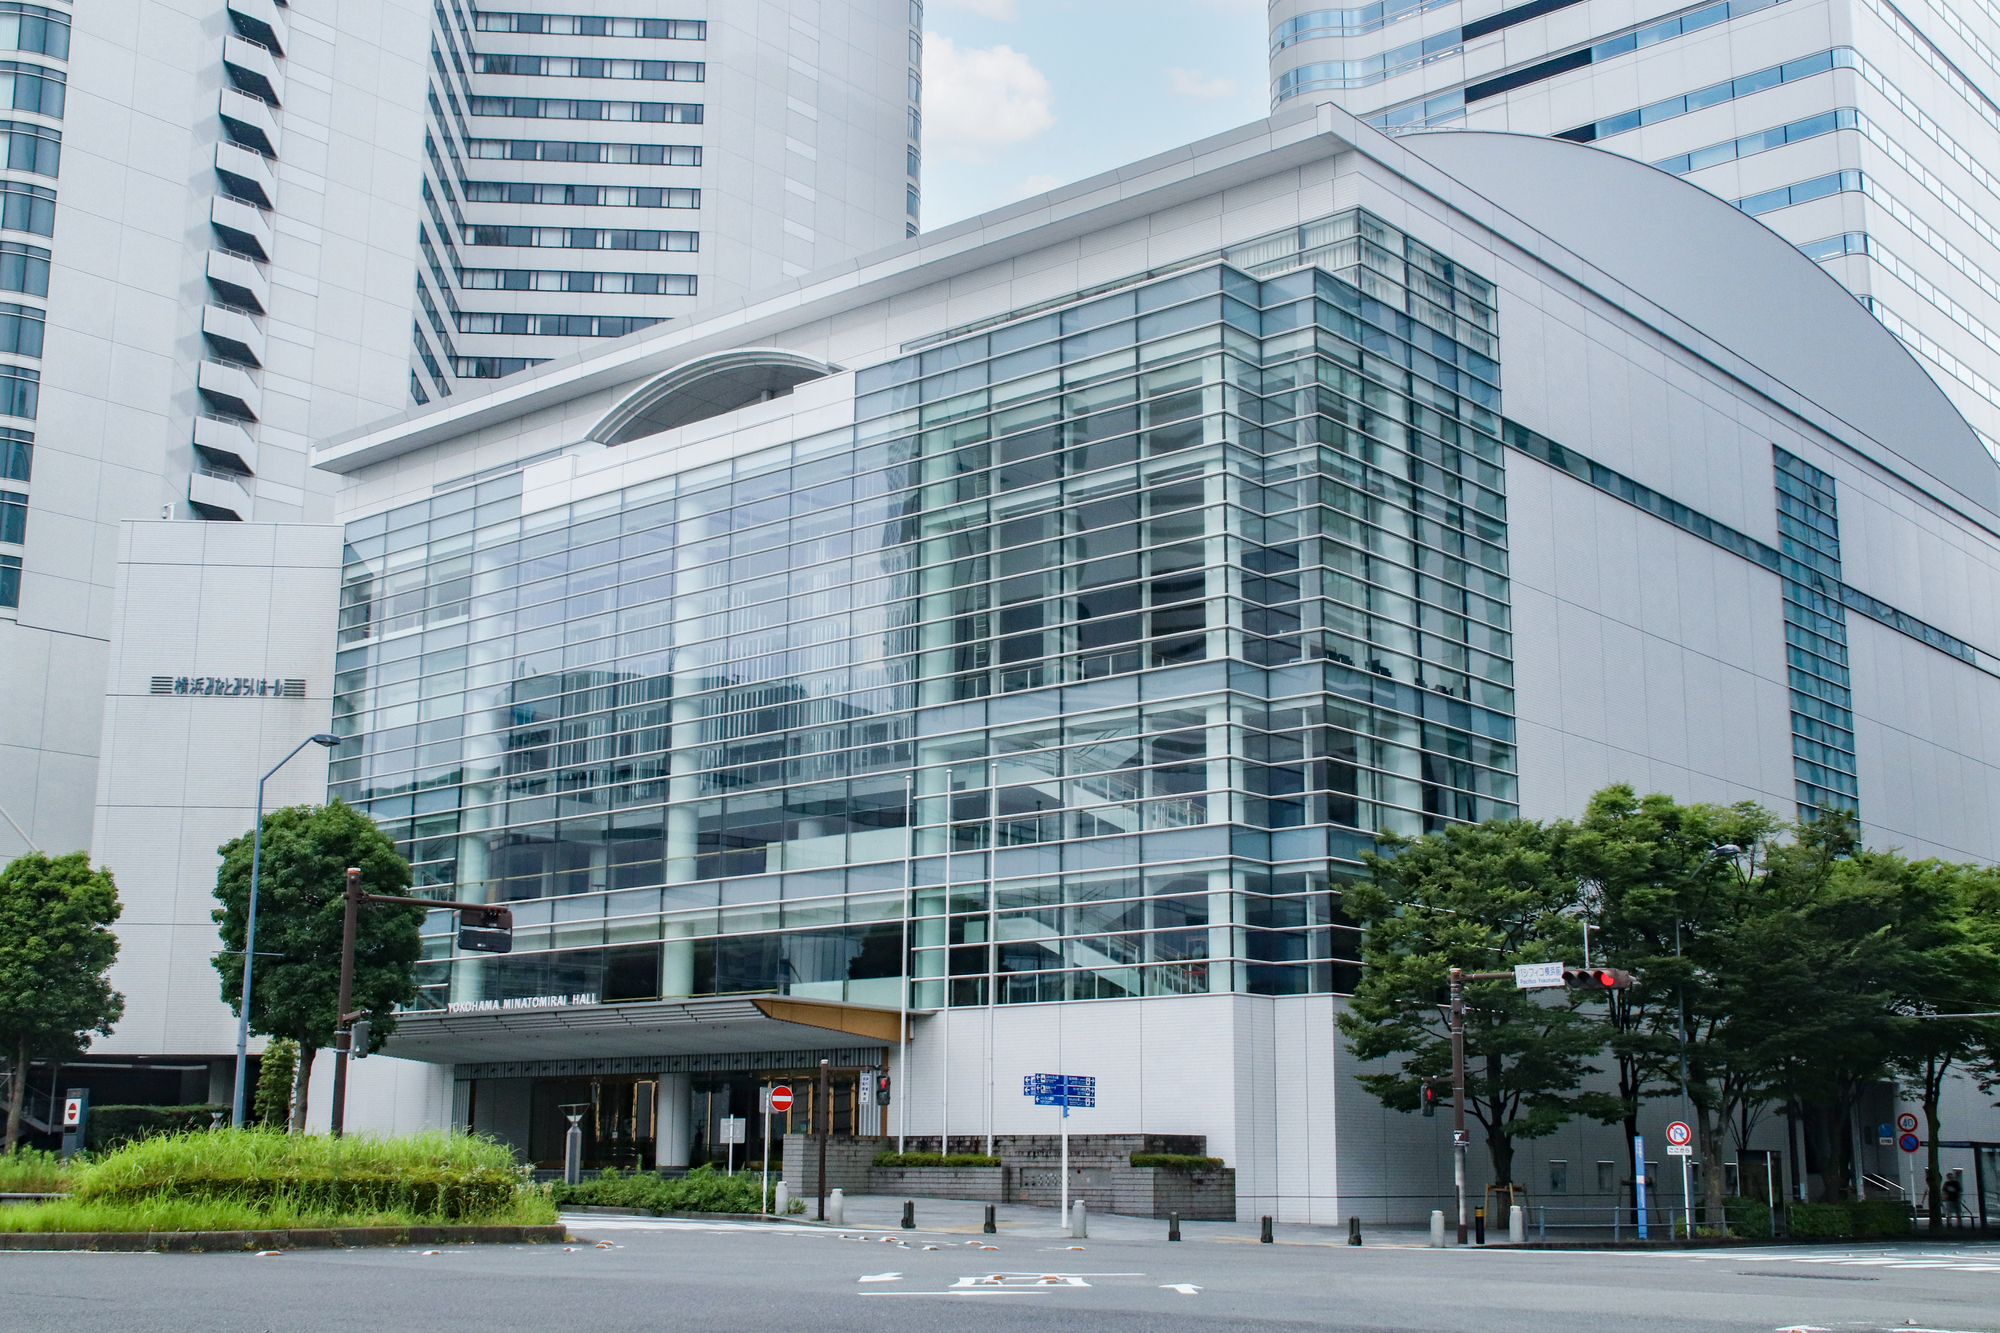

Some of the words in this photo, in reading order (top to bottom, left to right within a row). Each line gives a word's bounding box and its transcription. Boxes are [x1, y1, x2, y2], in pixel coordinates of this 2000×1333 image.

[174, 676, 283, 697] 横浜みなとみらいホール
[1520, 966, 1561, 978] パシフィコ横浜前
[447, 999, 500, 1013] YOKOHAMA
[502, 994, 568, 1010] MINATOMIRAI
[572, 992, 597, 1005] HALL
[1902, 1118, 1914, 1128] 40
